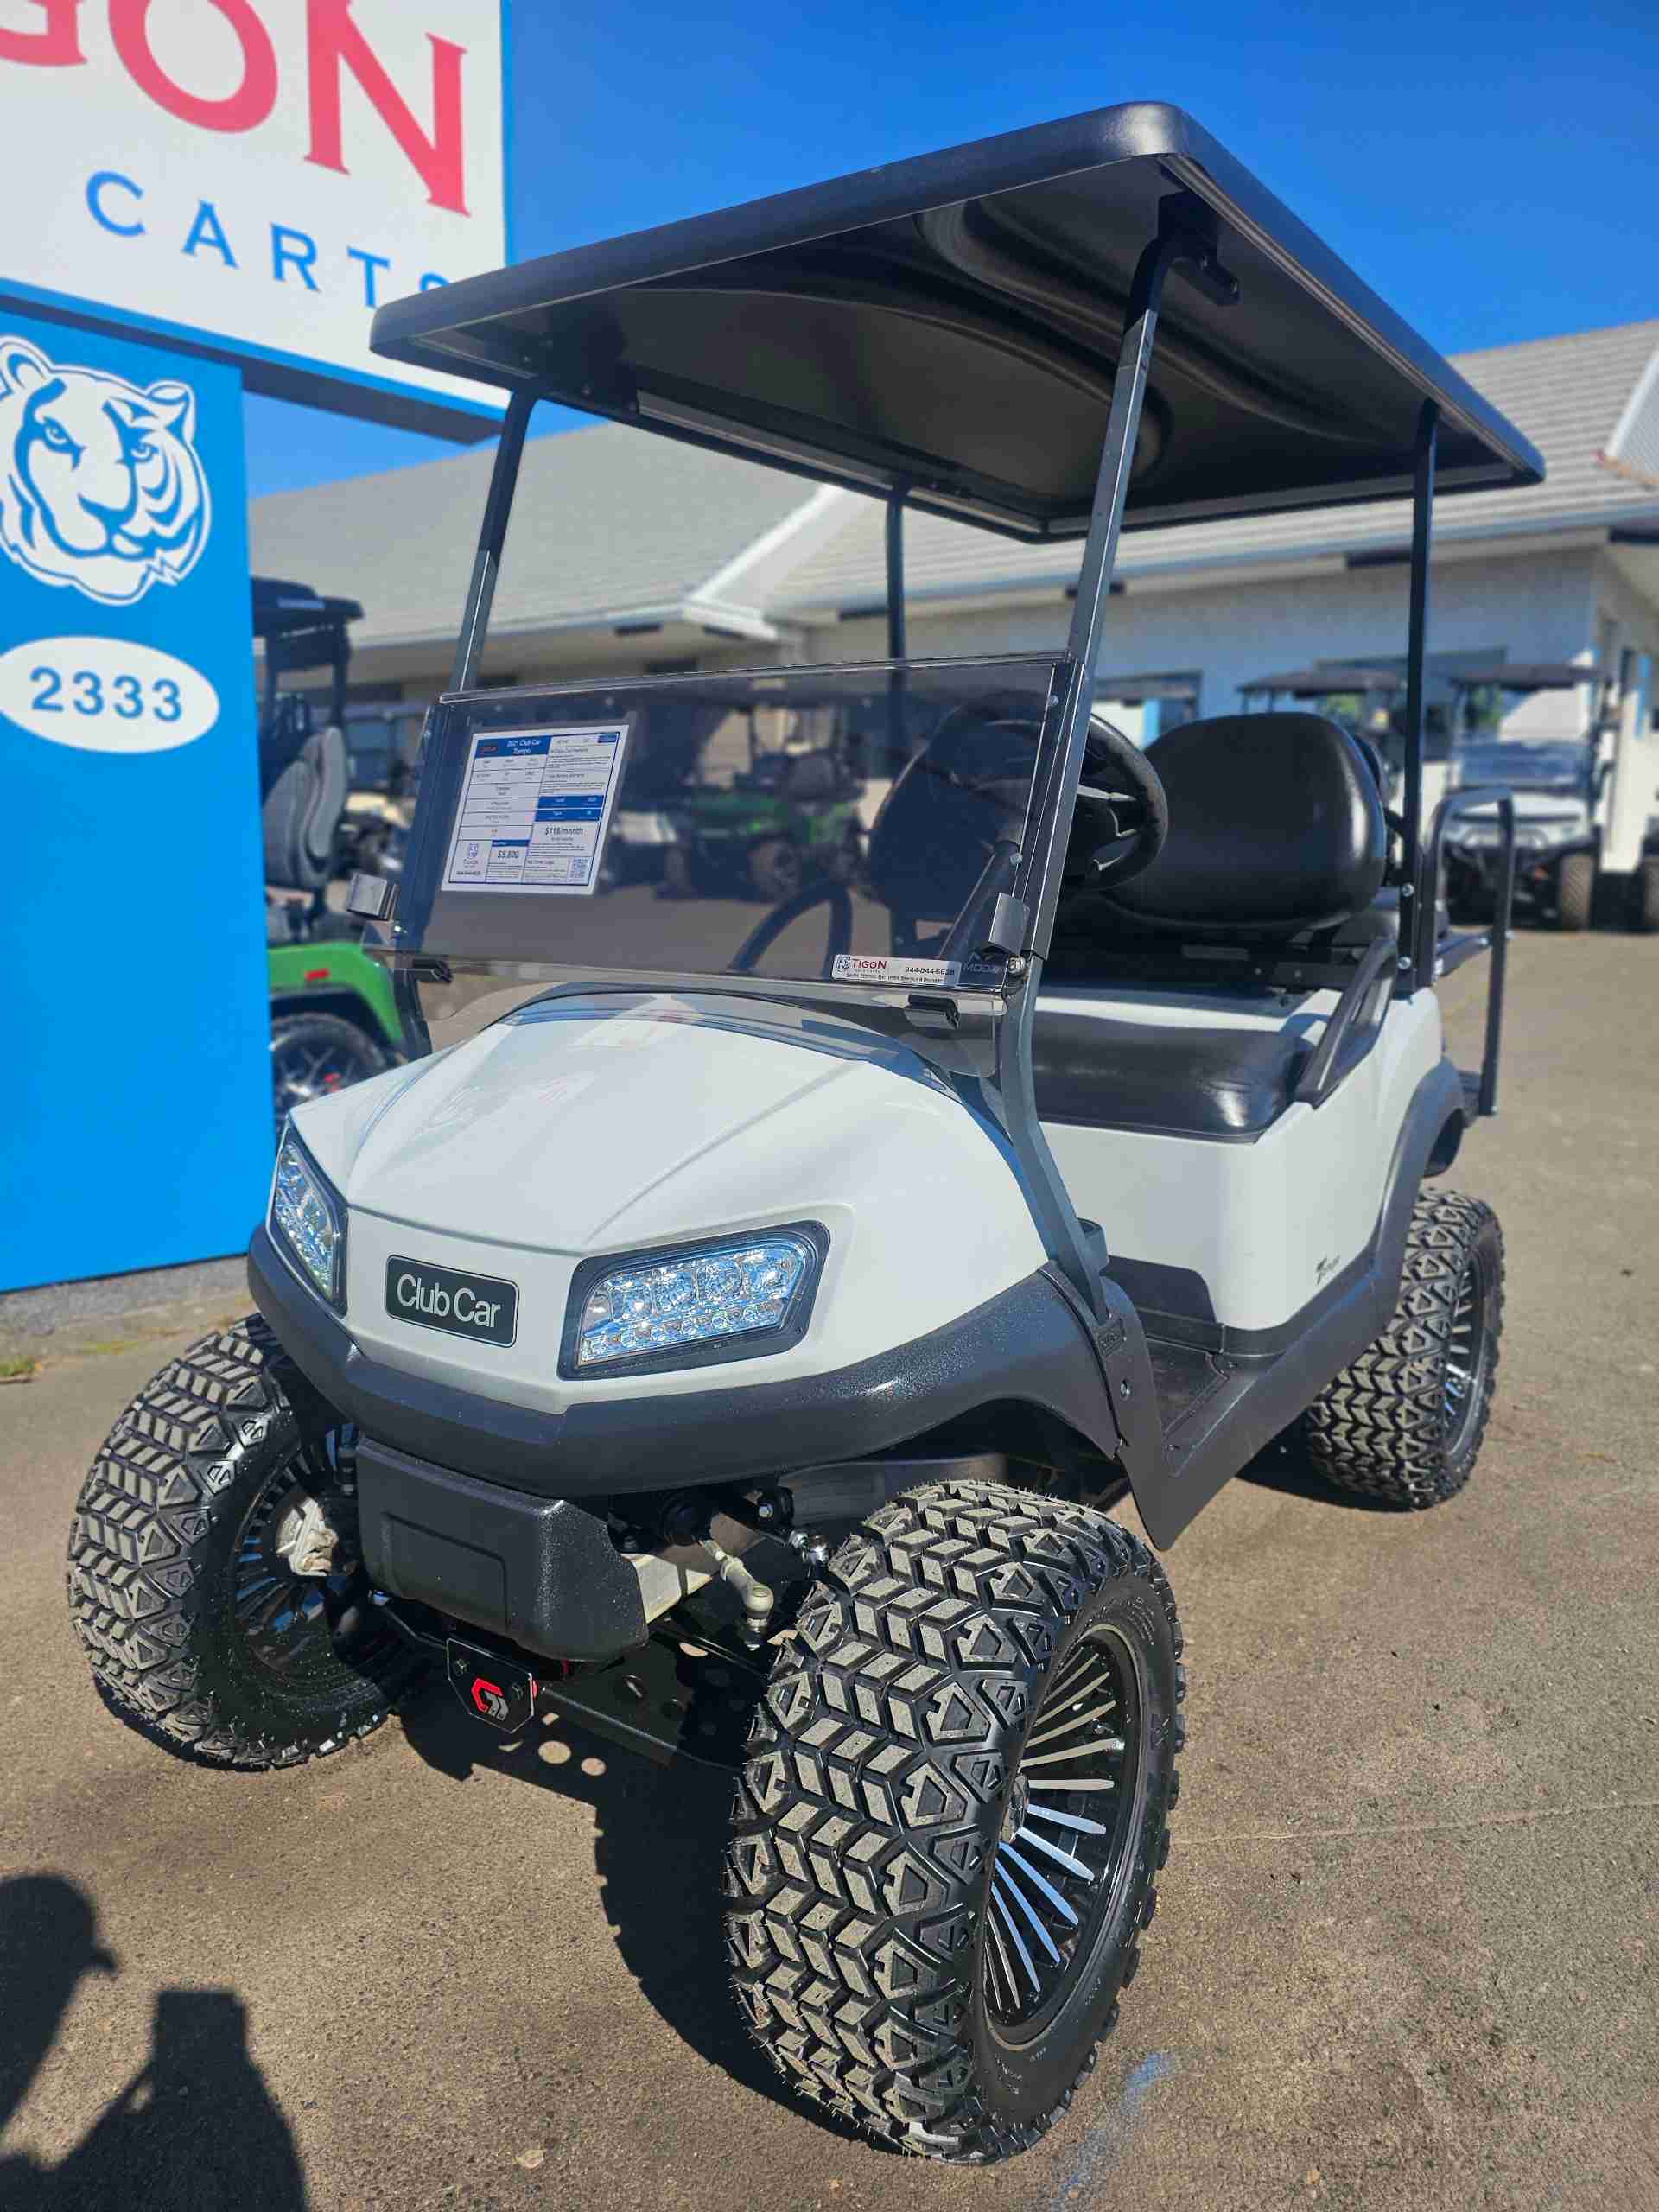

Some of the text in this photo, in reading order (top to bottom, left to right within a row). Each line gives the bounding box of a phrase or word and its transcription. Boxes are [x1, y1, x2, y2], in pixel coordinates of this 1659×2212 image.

[0, 0, 470, 216] ON
[29, 665, 182, 722] 2333
[397, 1274, 501, 1328] Club Car
